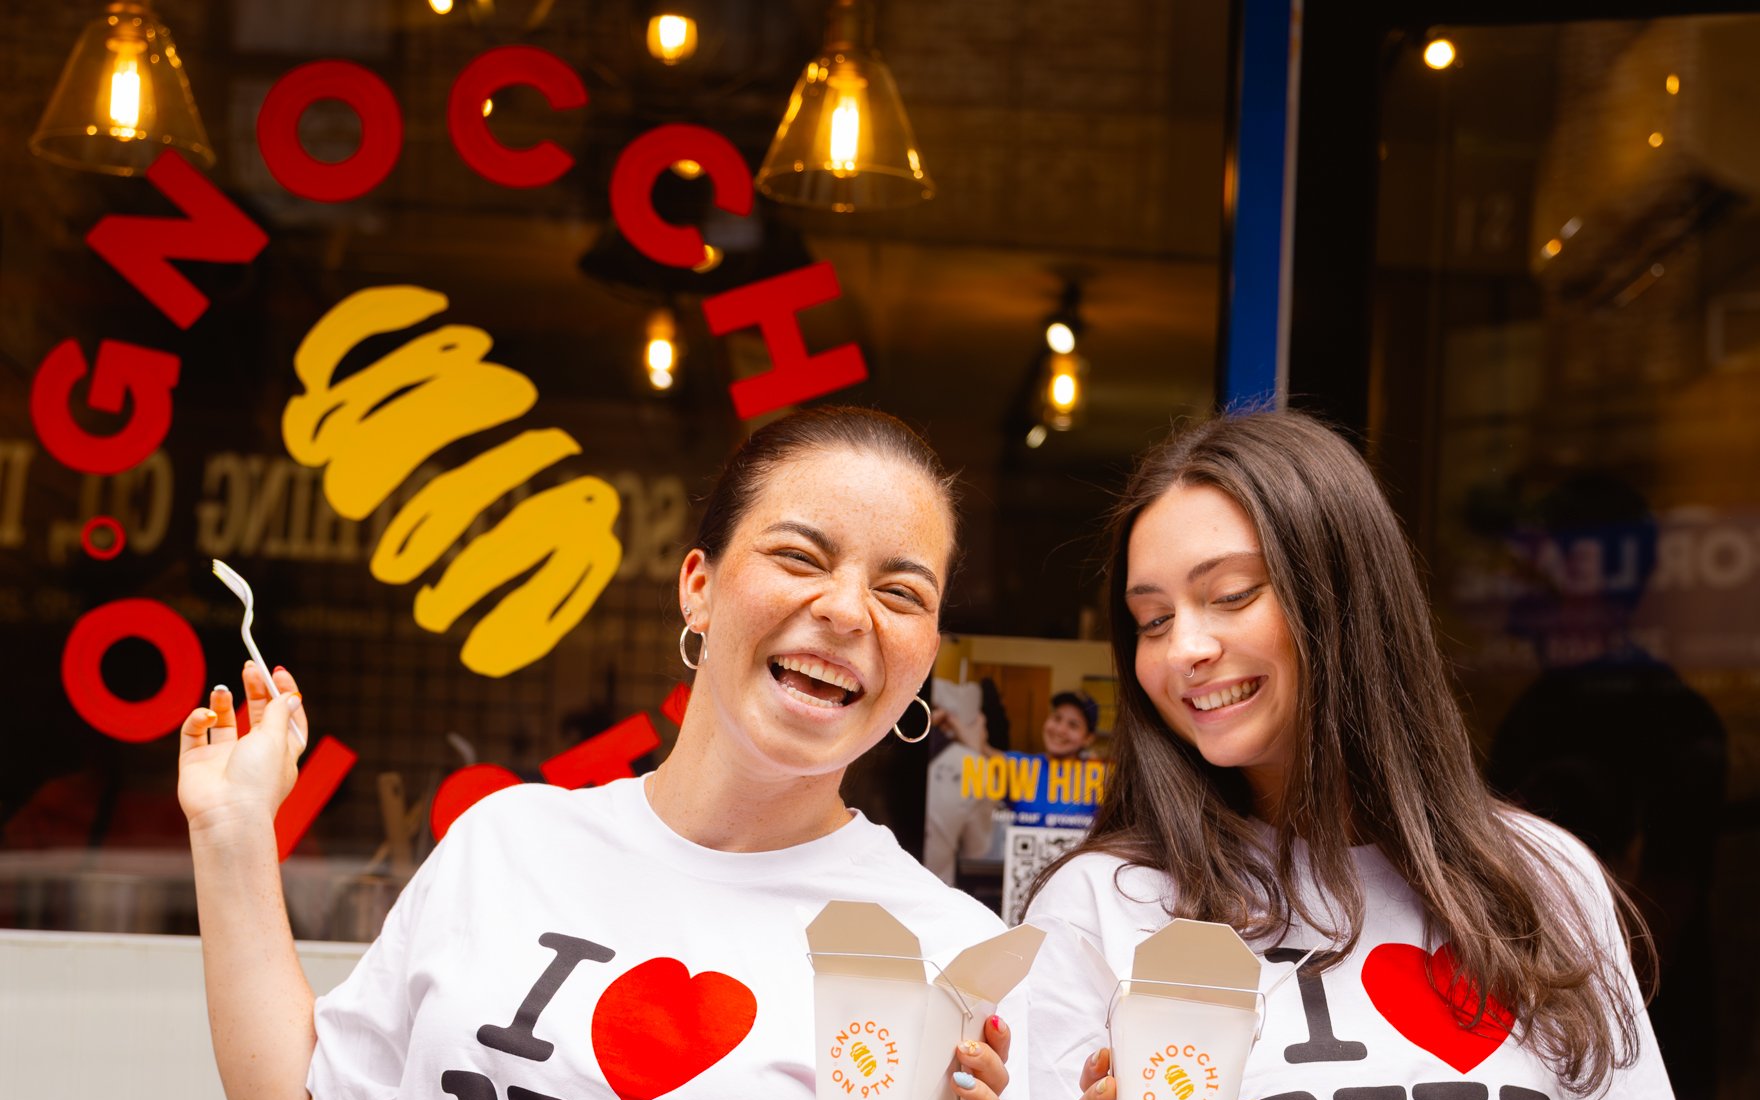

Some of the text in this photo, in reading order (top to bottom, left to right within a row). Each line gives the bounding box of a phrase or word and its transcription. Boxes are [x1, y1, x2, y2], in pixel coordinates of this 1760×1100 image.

[31, 46, 868, 476] GNOCCH
[961, 753, 1110, 807] NOW HIR
[476, 931, 617, 1063] I
[1263, 946, 1369, 1064] I
[830, 1020, 900, 1065] GNOCCHI
[1141, 1043, 1220, 1091] GNOCCHI
[831, 1069, 895, 1099] ON 9TH
